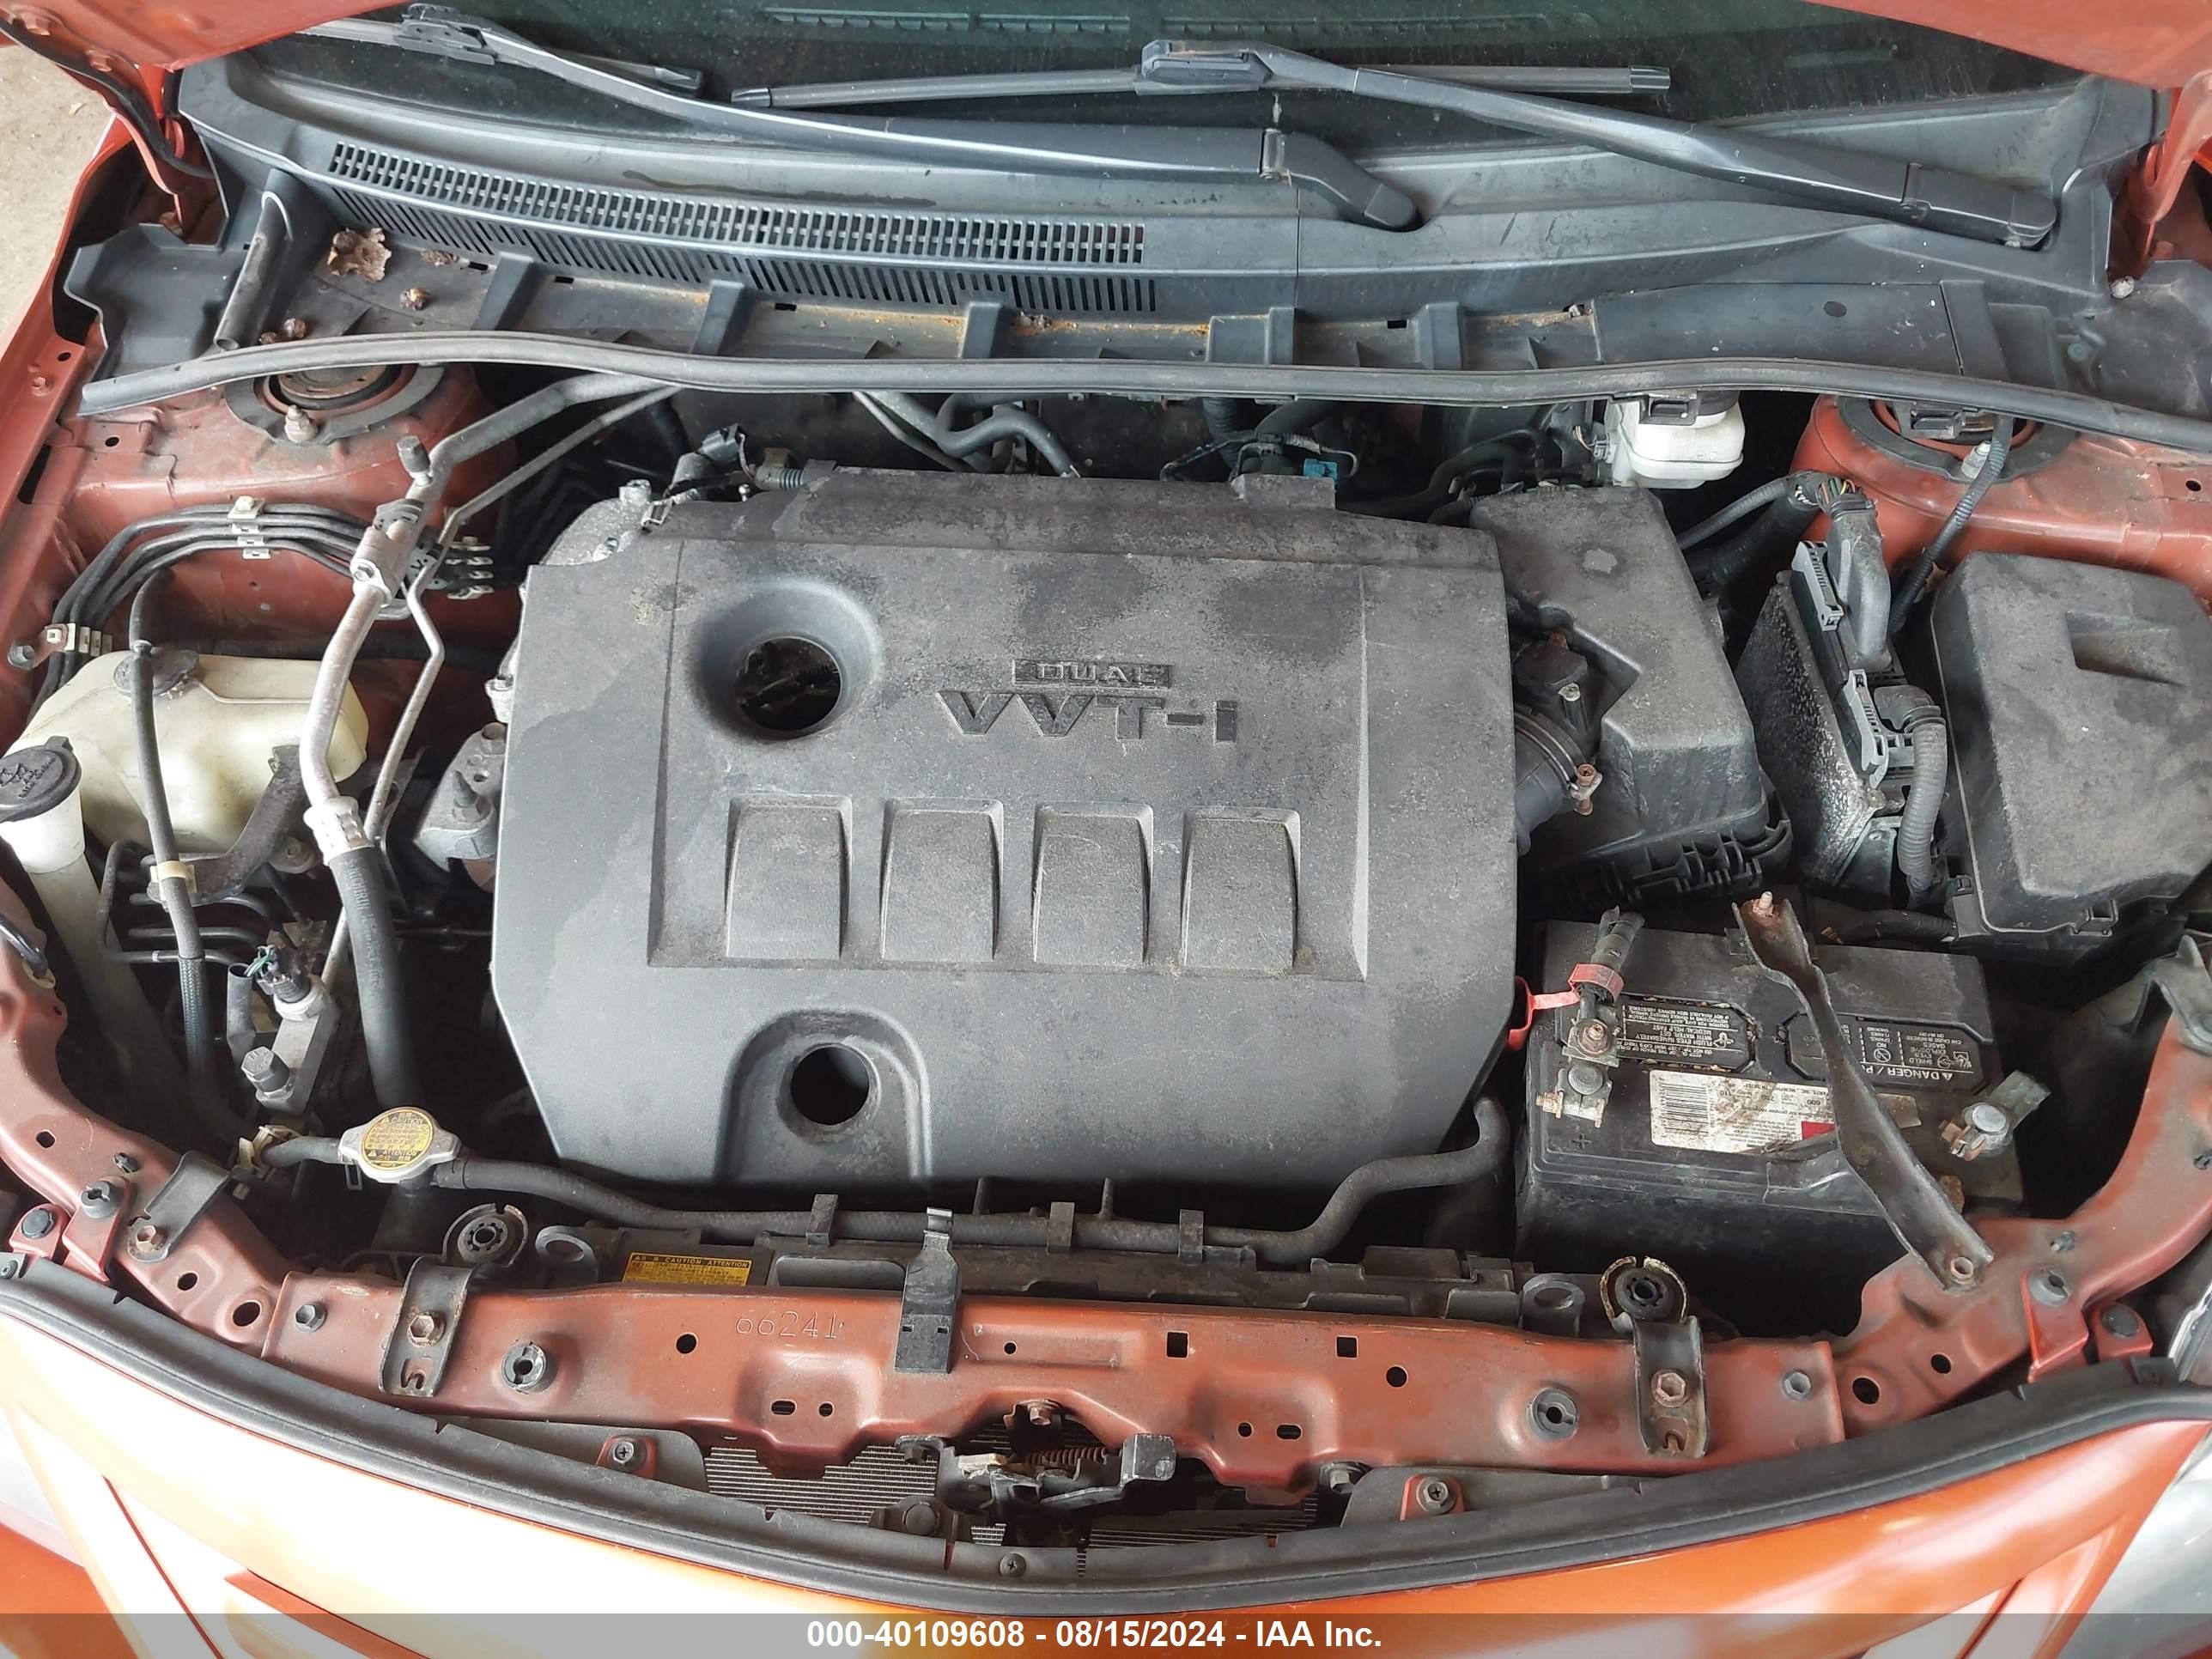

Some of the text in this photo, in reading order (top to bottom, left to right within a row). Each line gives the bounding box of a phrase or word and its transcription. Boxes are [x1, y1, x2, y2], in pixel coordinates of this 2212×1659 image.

[1036, 662, 1157, 684] DUAL
[1685, 1027, 1711, 1036] MEDICAL
[1635, 1033, 1674, 1043] IMMEDIATELY
[1692, 1038, 1713, 1047] FLUSH
[1887, 1066, 1939, 1080] DANGER
[381, 1149, 417, 1158] ATTENTION
[665, 1256, 702, 1265] CAUTION
[707, 1260, 748, 1268] ATTENTION
[735, 1311, 837, 1340] 66241
